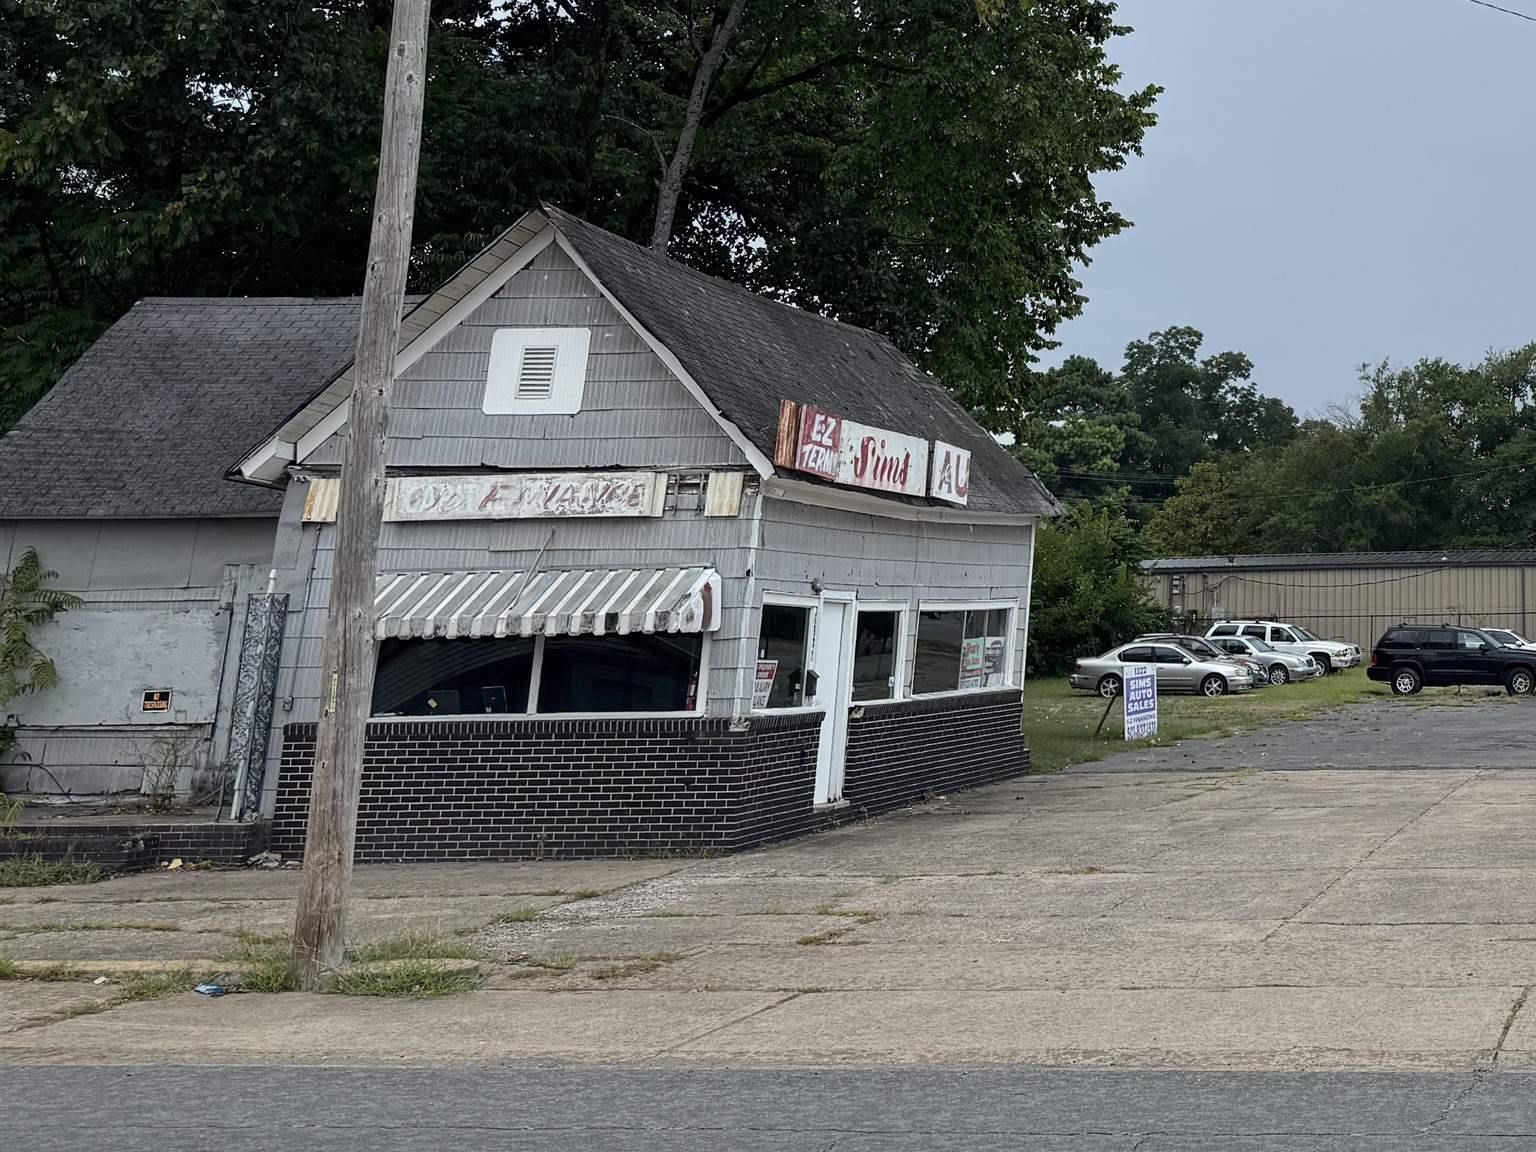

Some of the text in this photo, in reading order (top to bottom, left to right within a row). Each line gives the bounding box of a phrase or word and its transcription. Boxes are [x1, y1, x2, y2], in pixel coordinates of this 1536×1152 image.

[1134, 666, 1147, 676] 1322
[1130, 677, 1151, 690] SIMS
[1129, 688, 1153, 701] AUTO
[1127, 699, 1155, 713] SALES
